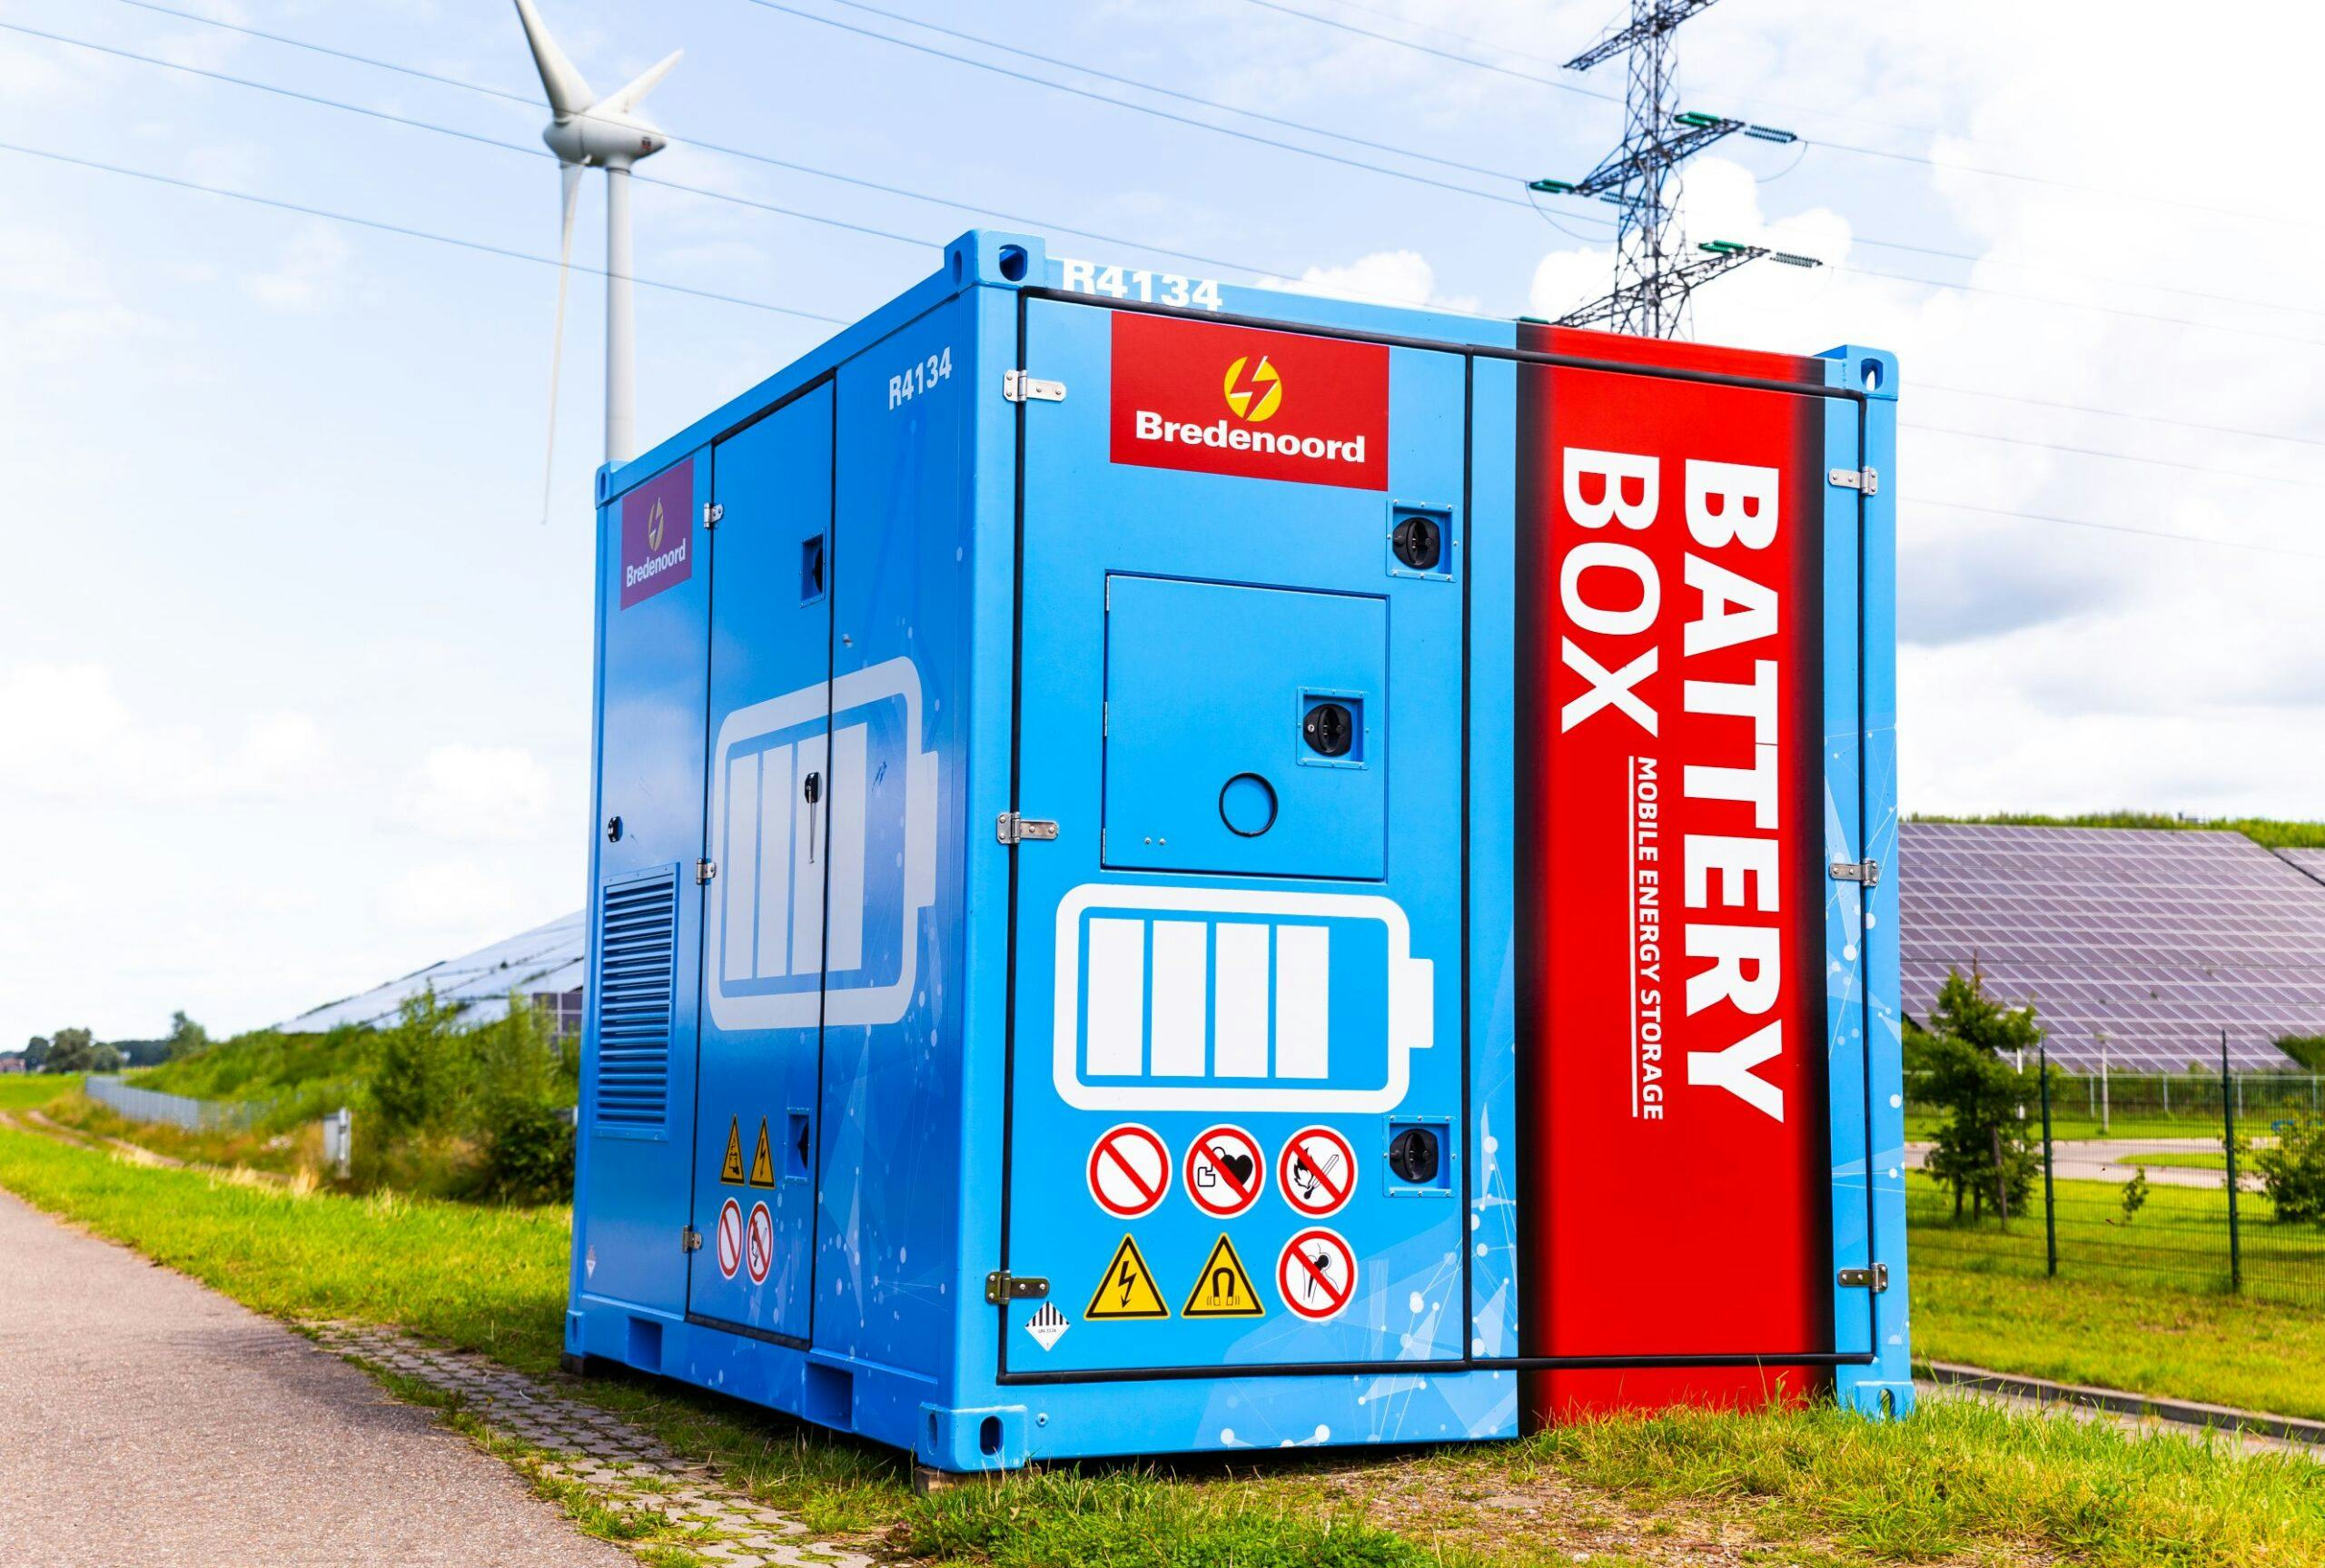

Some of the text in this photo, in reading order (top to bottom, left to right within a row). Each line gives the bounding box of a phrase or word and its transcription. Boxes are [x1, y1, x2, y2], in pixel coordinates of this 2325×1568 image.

[1063, 258, 1222, 311] R4134
[889, 346, 952, 410] R4134
[1136, 410, 1365, 462] Bredenoord
[627, 537, 686, 587] Bredenoord
[1560, 447, 1661, 738] BOX
[1684, 459, 1784, 1123] BATTERY
[1637, 756, 1664, 1119] MOBILE ENERGY STORAGE
